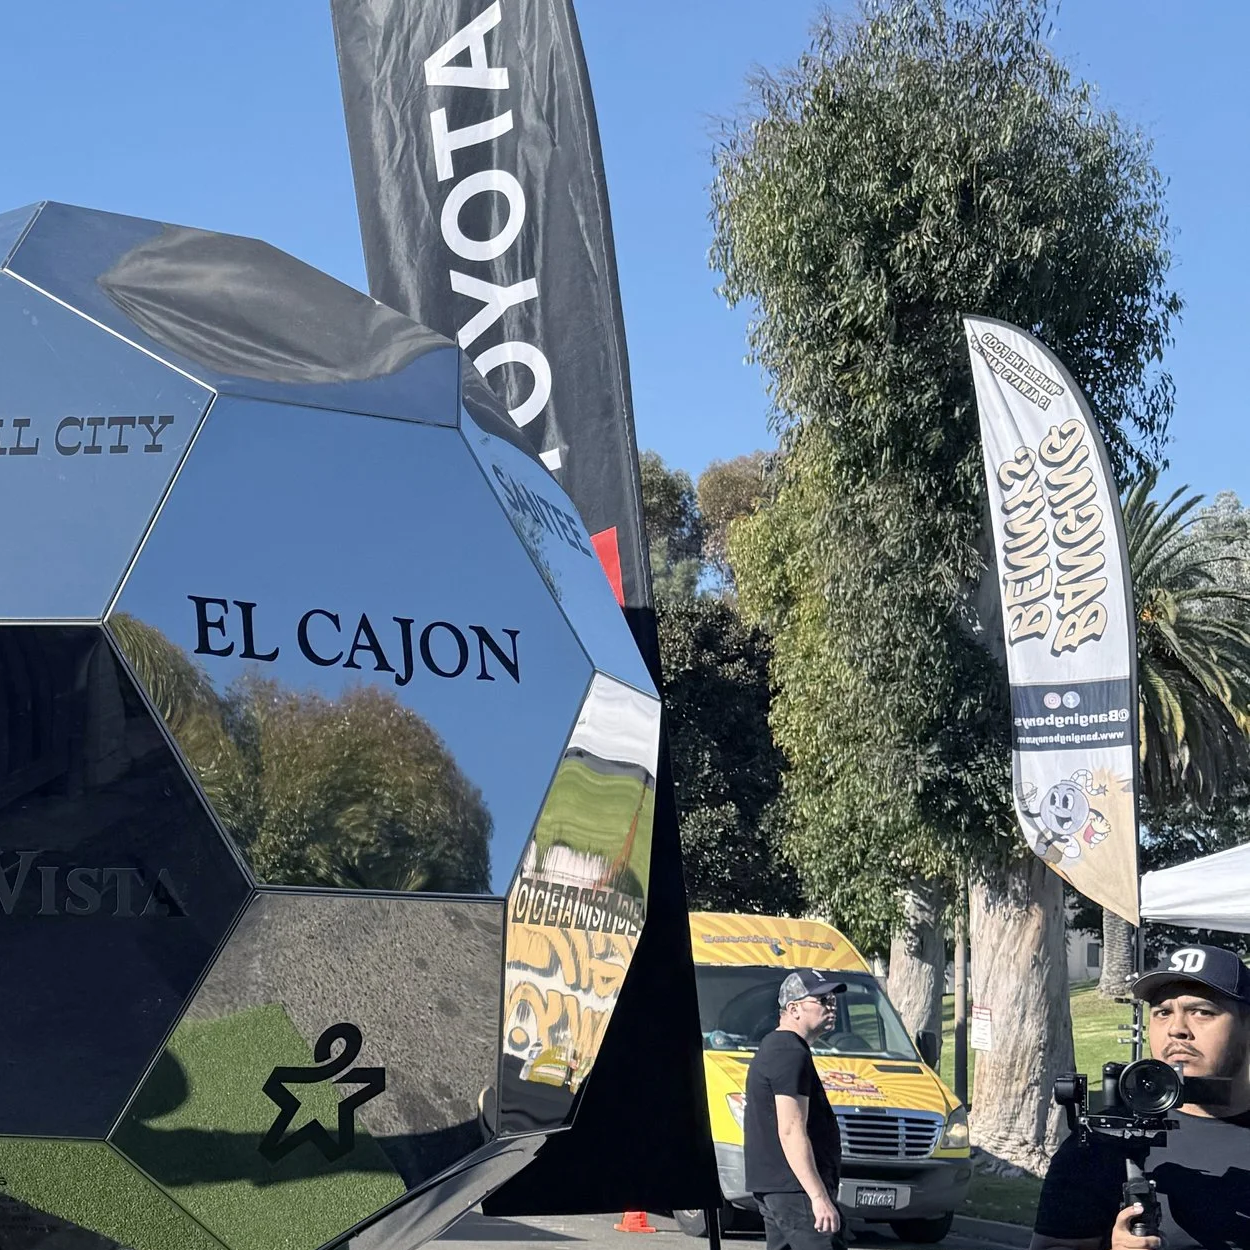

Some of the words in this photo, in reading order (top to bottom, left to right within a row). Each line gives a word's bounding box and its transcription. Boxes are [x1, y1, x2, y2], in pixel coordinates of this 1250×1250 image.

[424, 0, 561, 471] OYOTA
[54, 415, 175, 456] CITY
[492, 464, 593, 559] SANTEE
[187, 594, 280, 662] EL
[297, 608, 521, 687] CAJON
[513, 880, 643, 937] OCEANSIDE
[1168, 948, 1207, 973] SD
